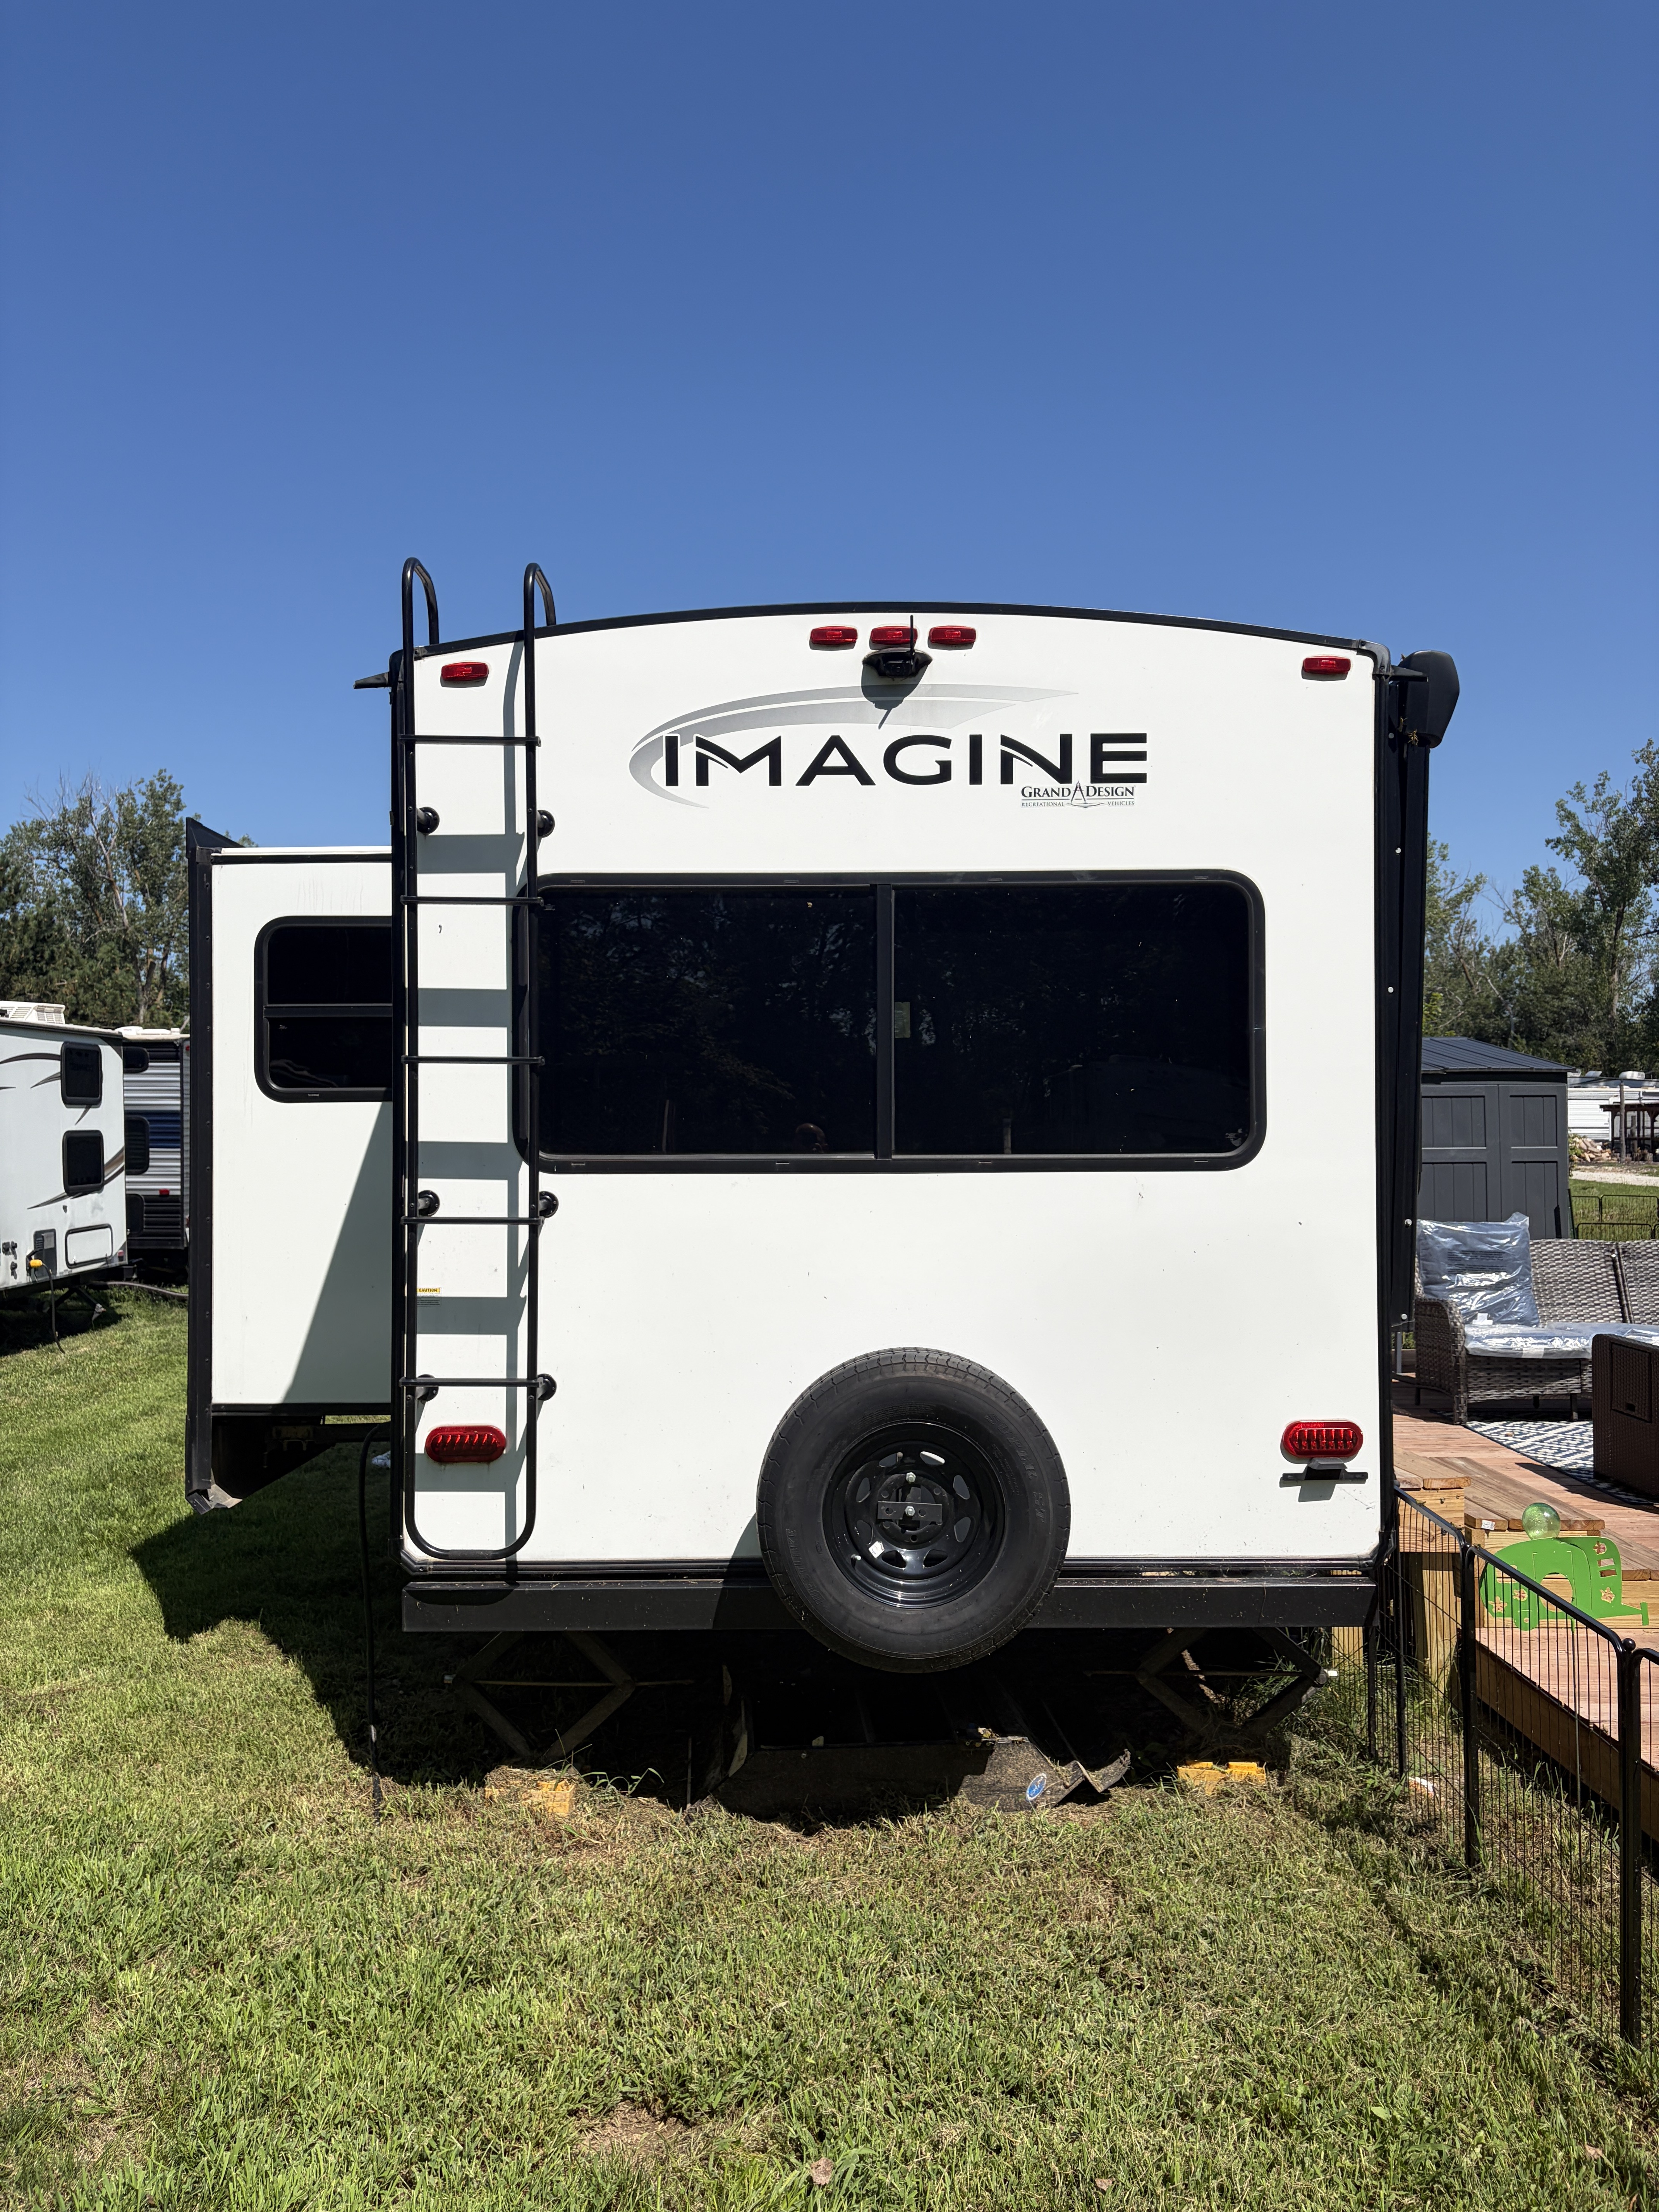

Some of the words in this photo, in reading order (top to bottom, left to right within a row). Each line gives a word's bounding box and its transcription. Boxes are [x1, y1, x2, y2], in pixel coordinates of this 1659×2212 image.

[665, 733, 1147, 787] IMAGINE
[1021, 786, 1071, 798] GRAND
[1086, 785, 1134, 797] DESIGN
